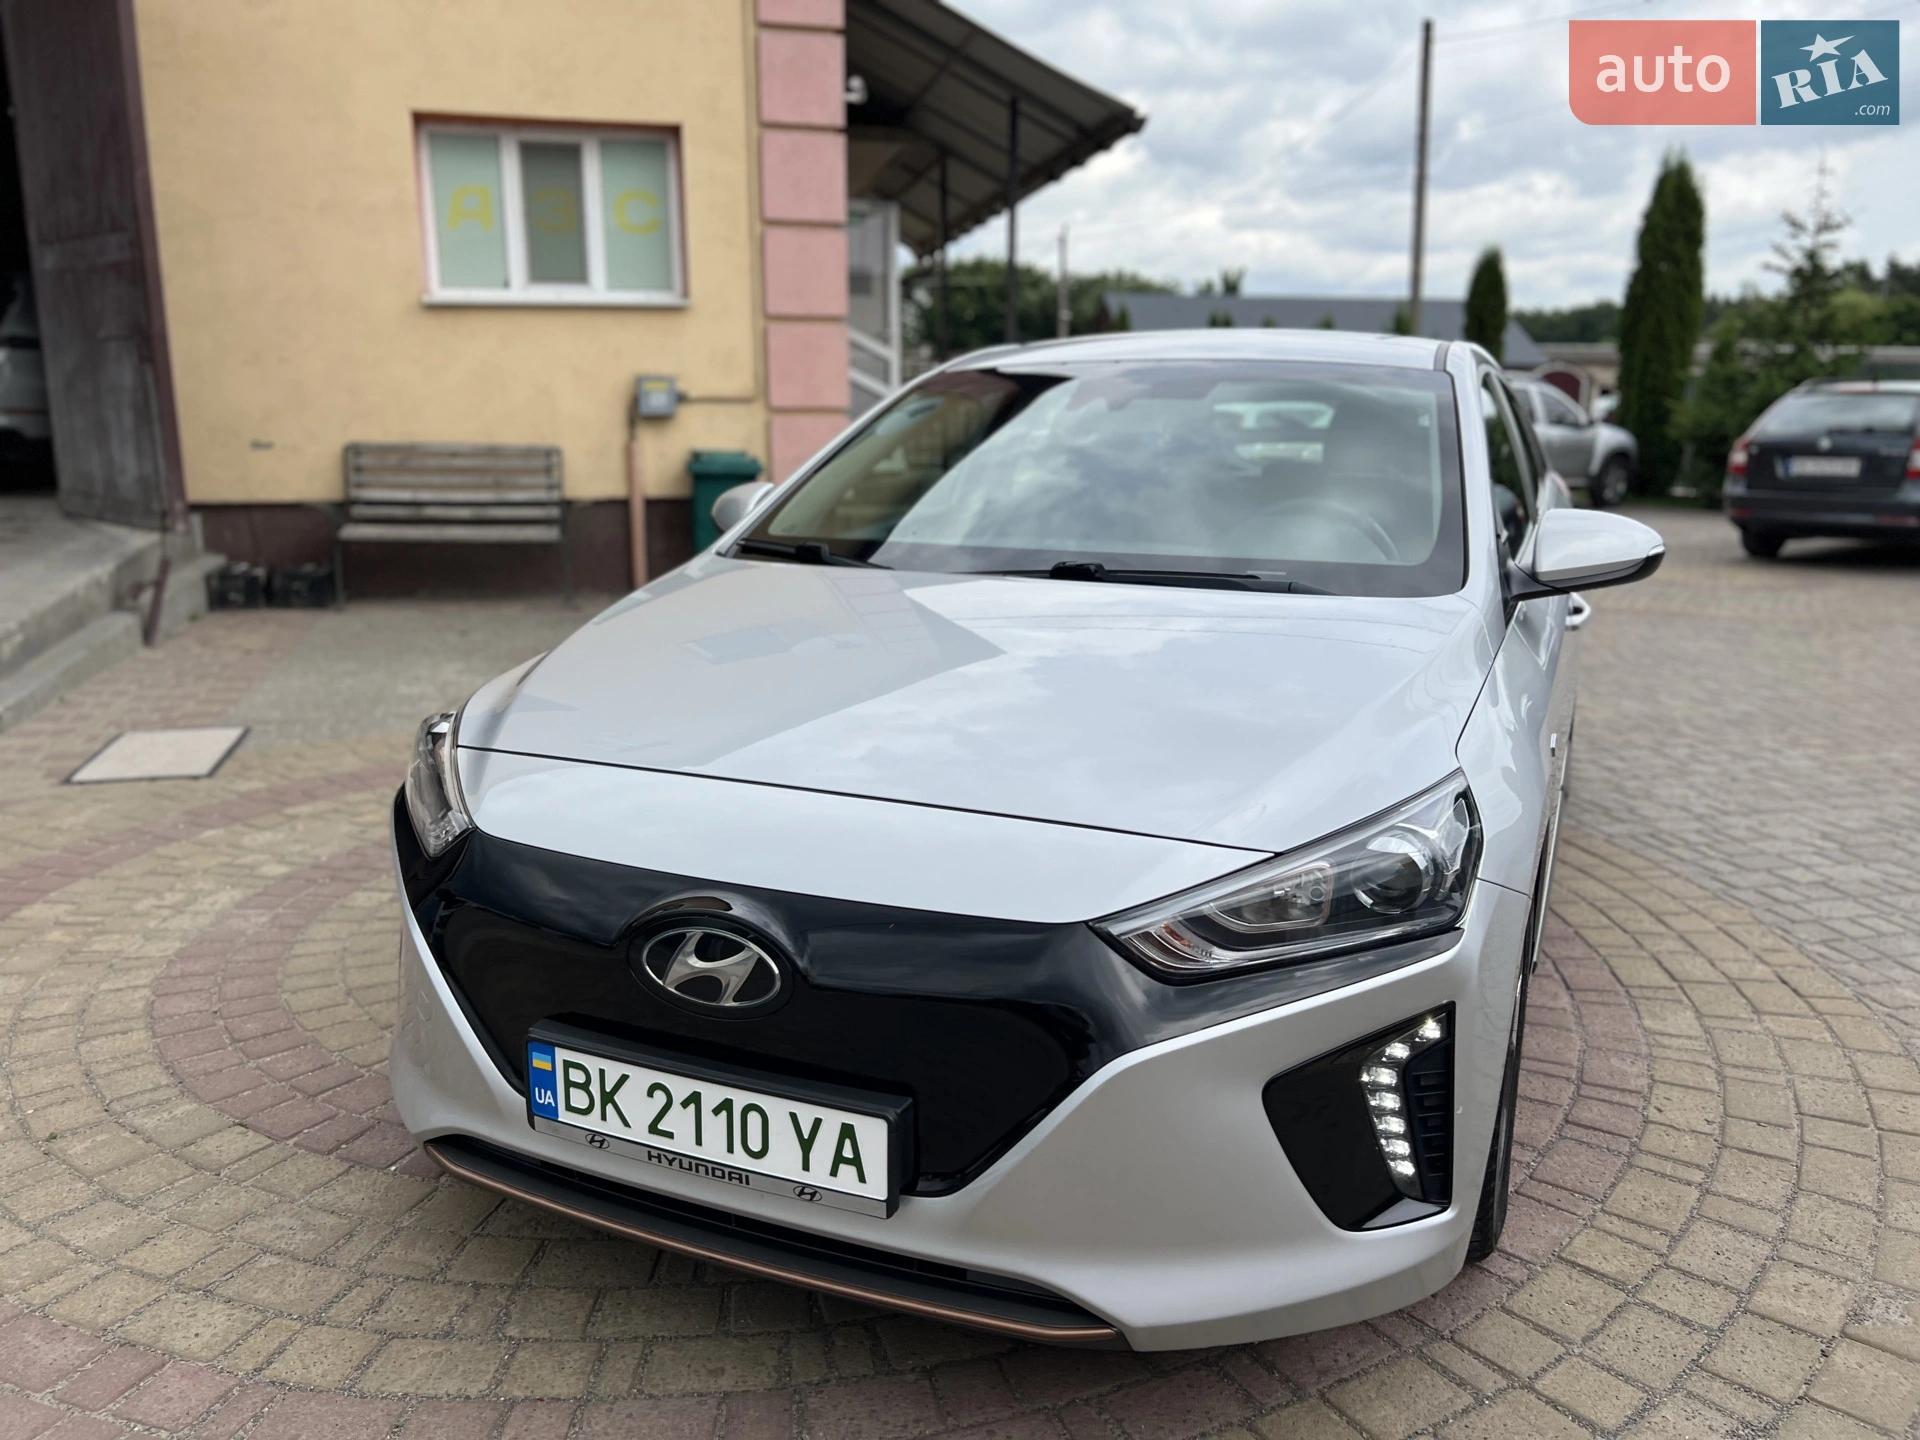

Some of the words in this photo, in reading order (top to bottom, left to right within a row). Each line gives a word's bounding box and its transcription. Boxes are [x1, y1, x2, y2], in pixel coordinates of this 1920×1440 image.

[535, 1087, 555, 1107] UA
[562, 1059, 632, 1129] BK
[646, 1082, 770, 1160] 2110
[789, 1111, 867, 1184] YA
[647, 1150, 750, 1186] HYUNDAI
